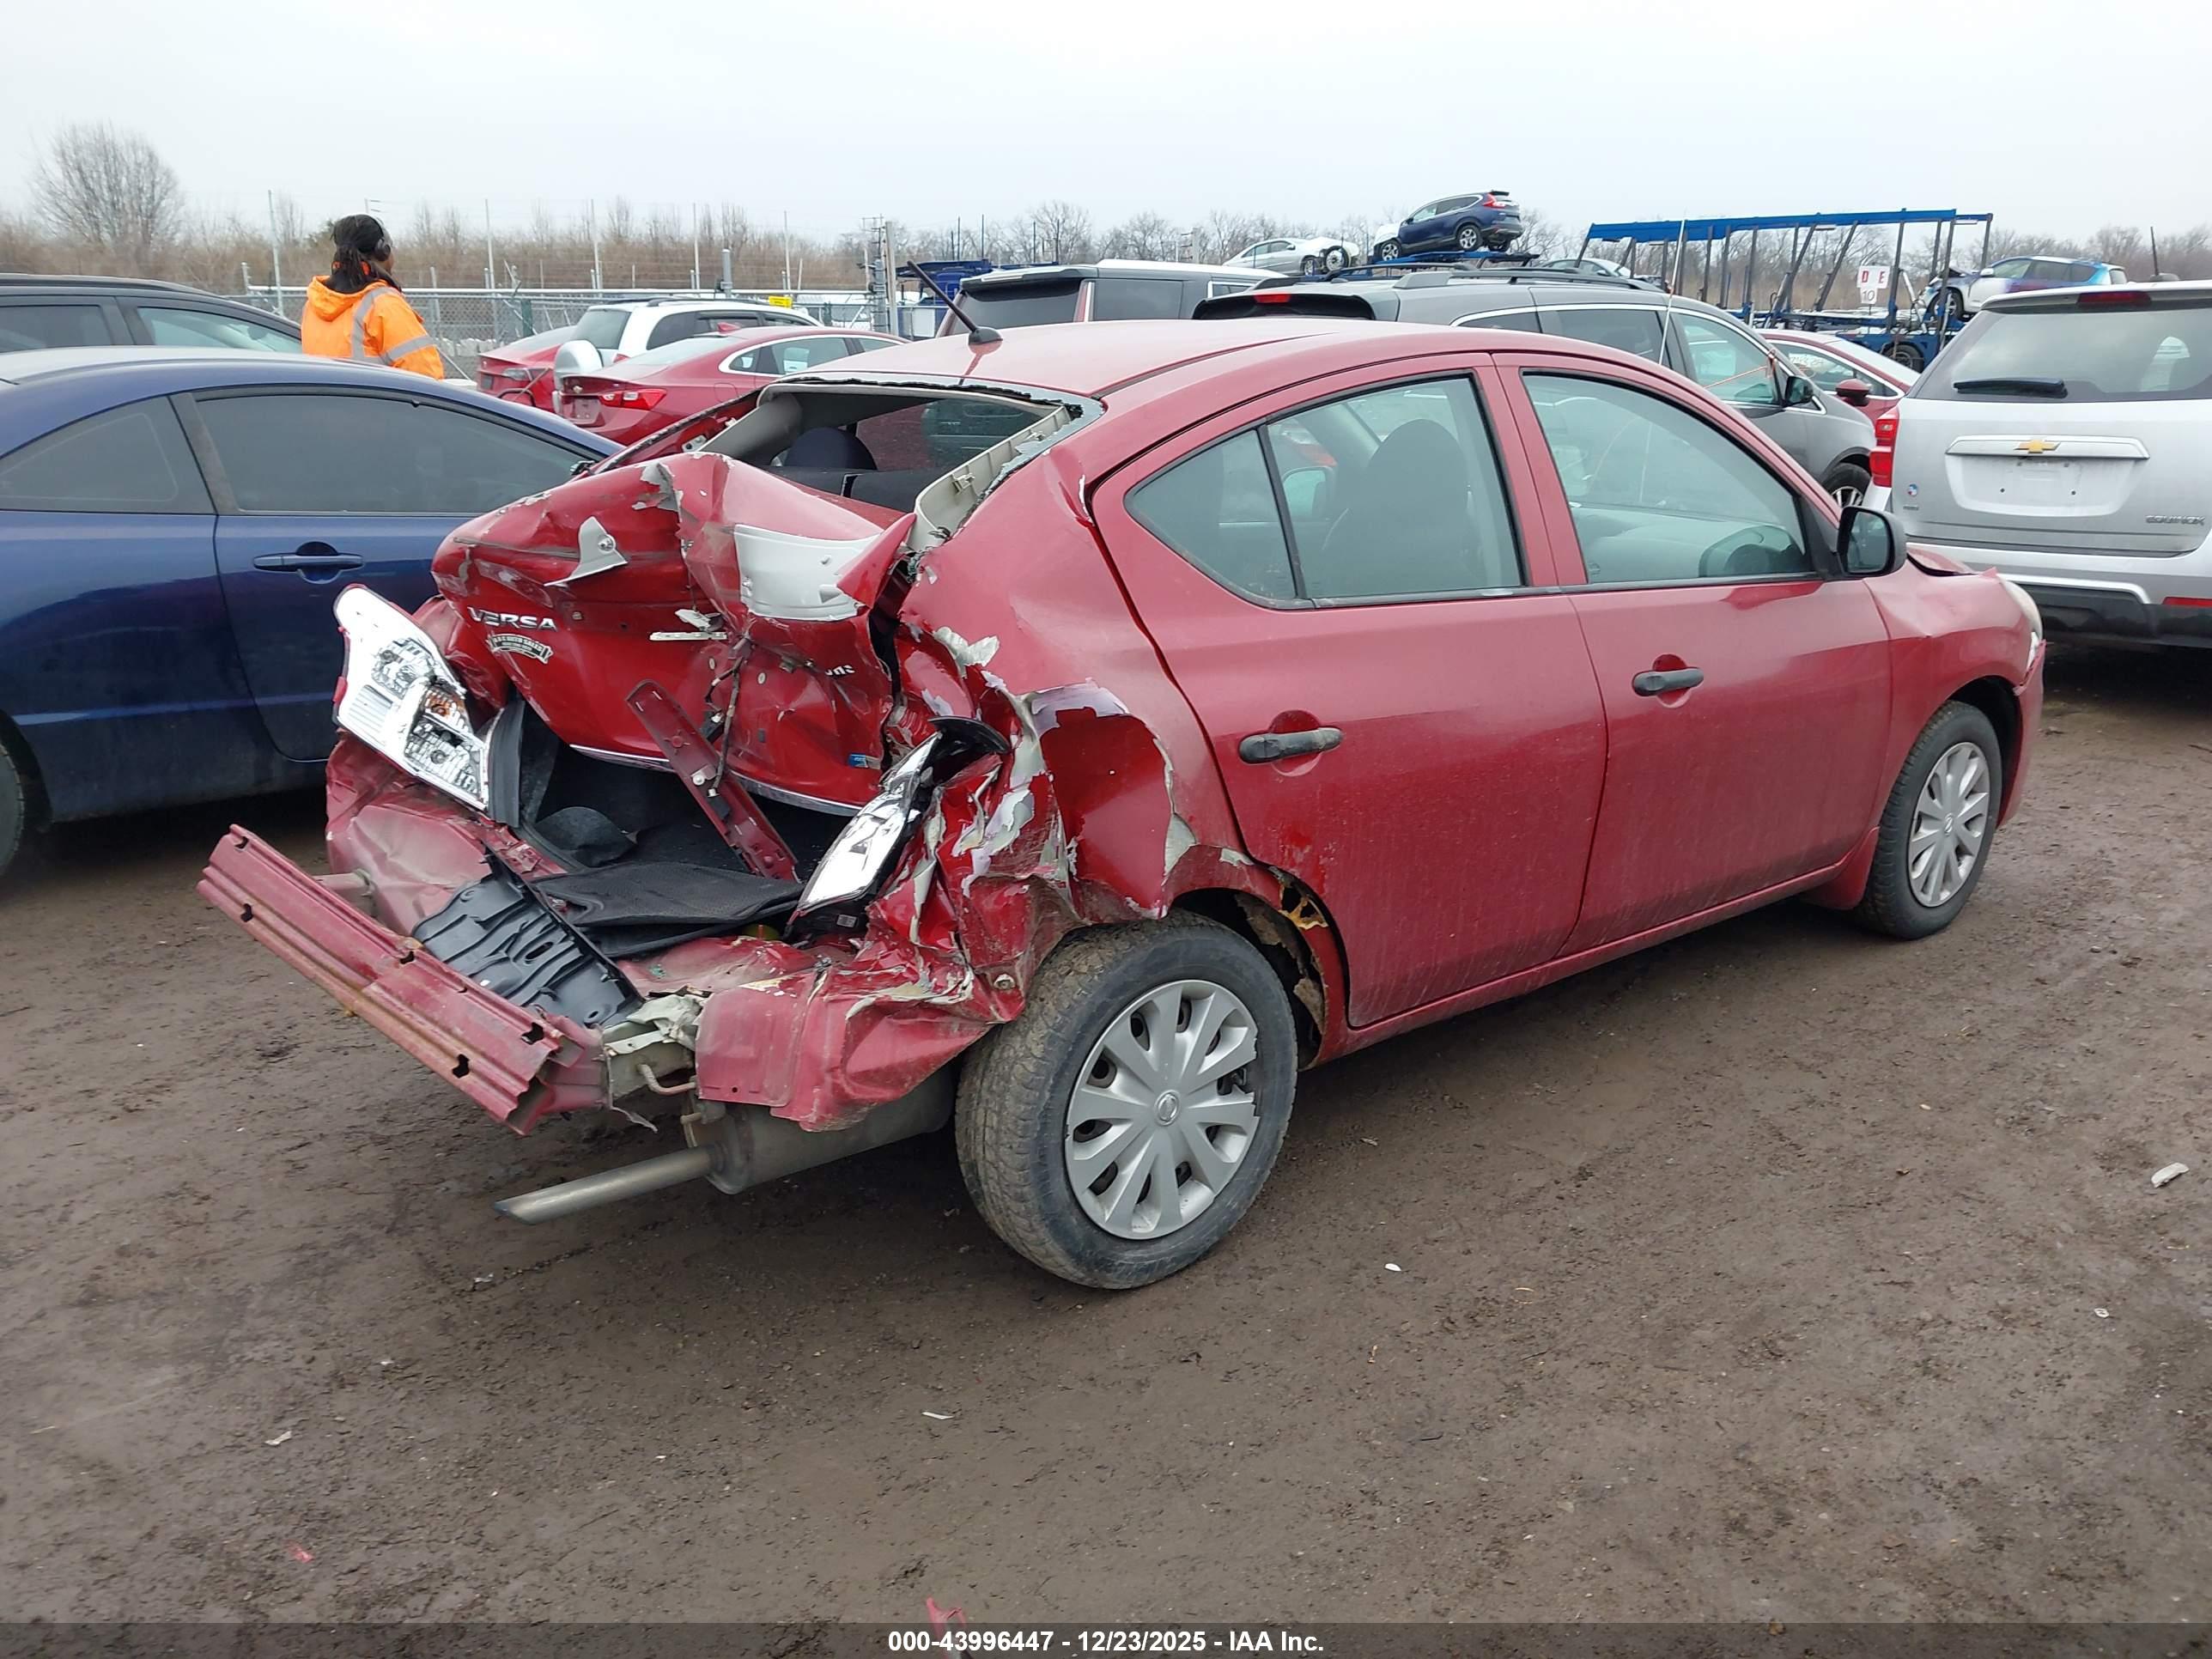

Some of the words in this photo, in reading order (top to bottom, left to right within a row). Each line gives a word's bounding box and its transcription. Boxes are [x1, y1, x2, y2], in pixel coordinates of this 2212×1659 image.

[1861, 270, 1869, 283] D
[1878, 270, 1886, 283] E
[1863, 289, 1875, 301] 10
[466, 605, 558, 632] VERSA
